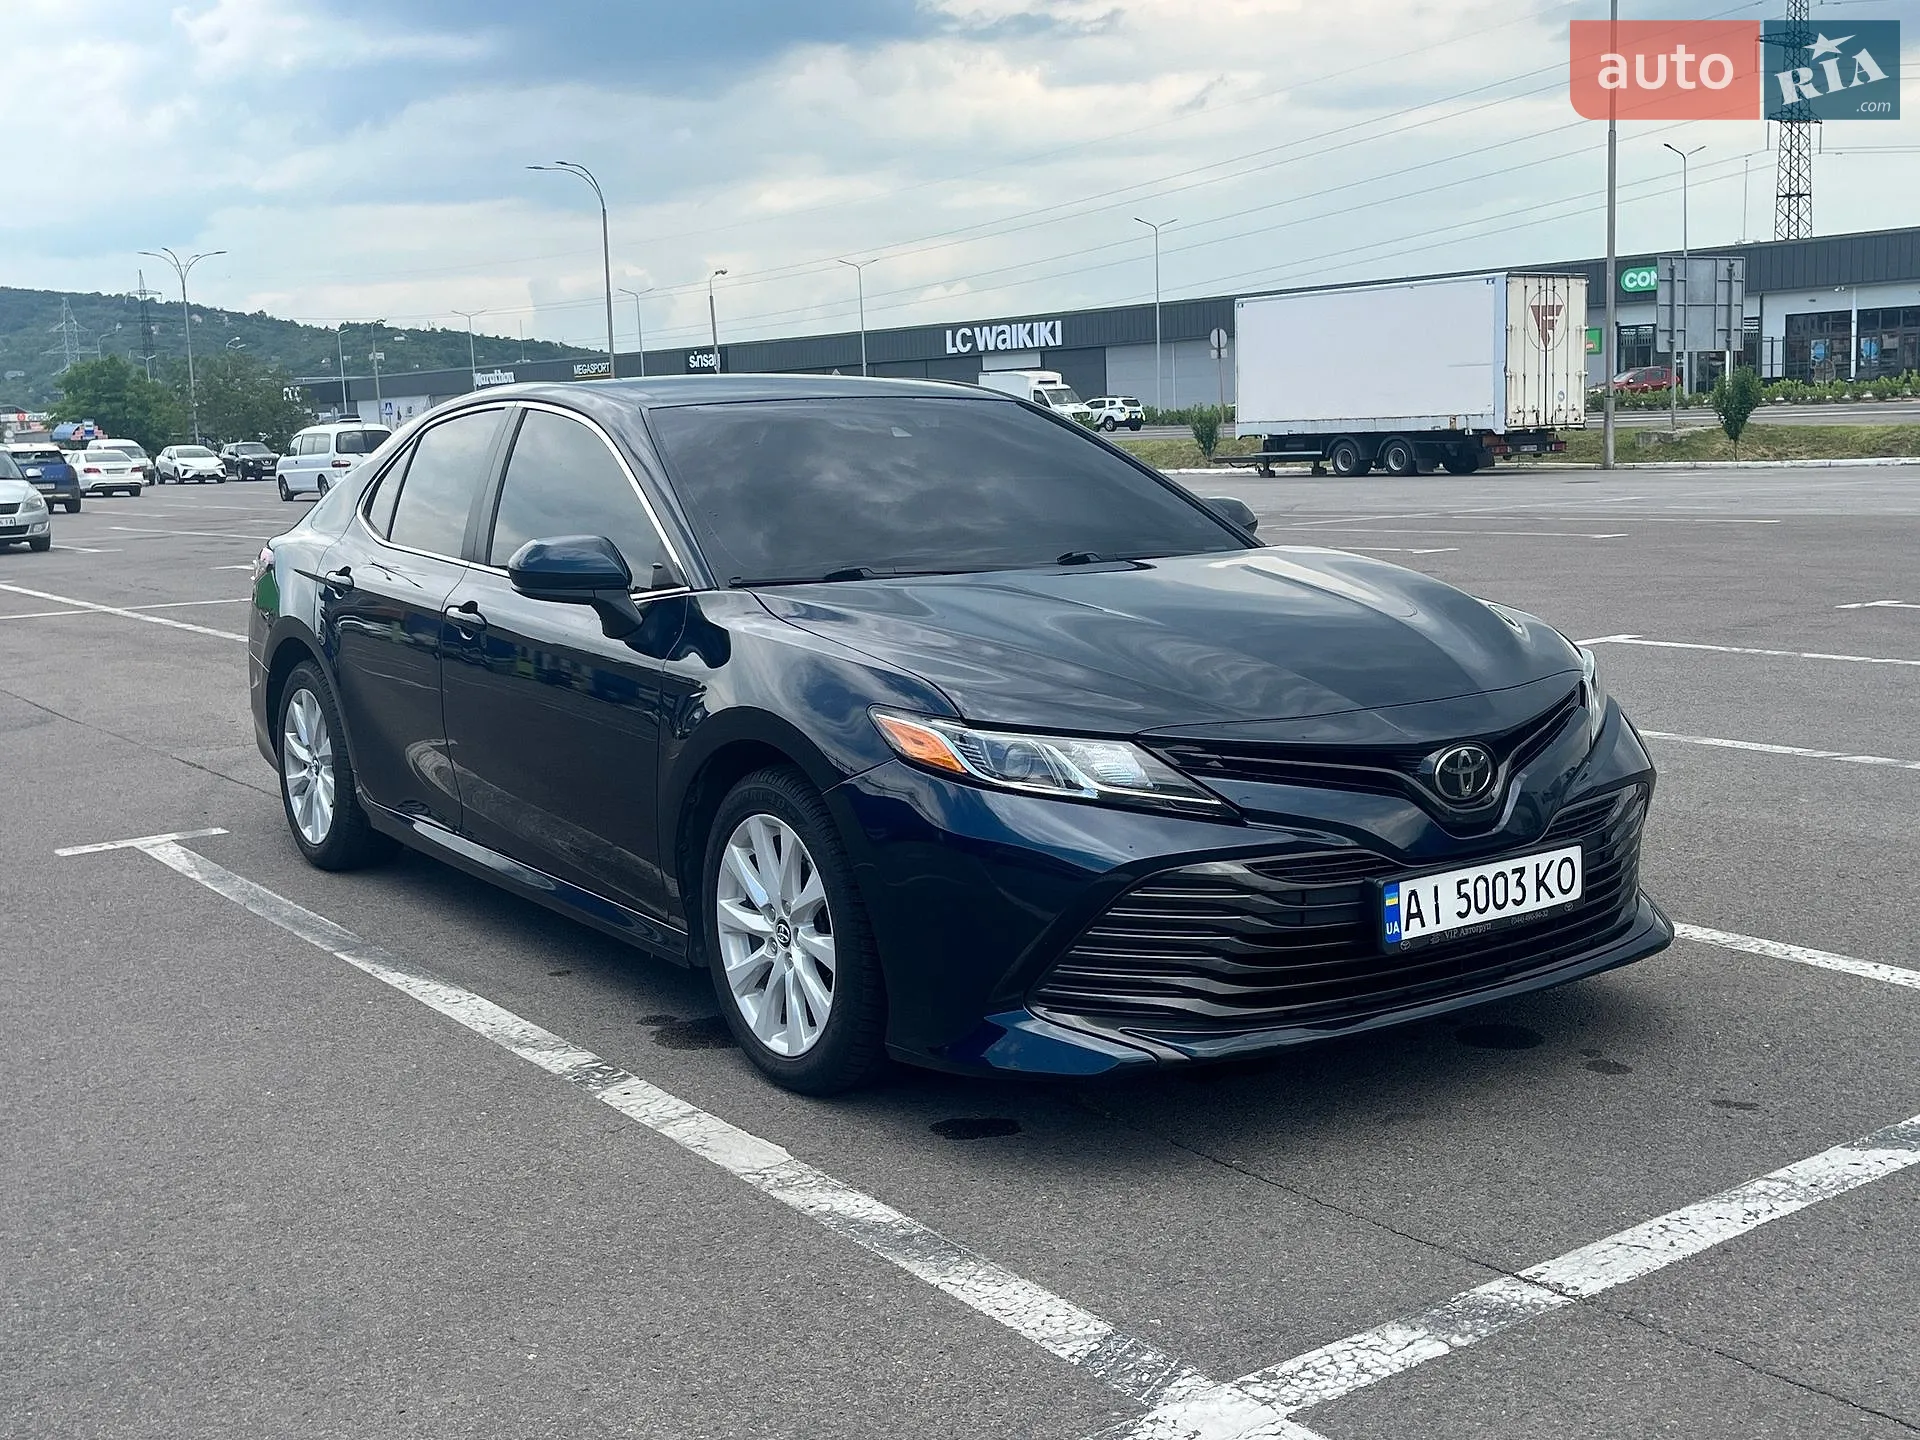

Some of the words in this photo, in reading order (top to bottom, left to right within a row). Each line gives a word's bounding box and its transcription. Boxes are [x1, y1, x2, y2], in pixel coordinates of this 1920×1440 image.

[945, 327, 973, 354] LC
[573, 361, 610, 375] MEGASPORT
[1404, 885, 1441, 931] AI
[1455, 866, 1527, 919] 5003
[1535, 856, 1576, 902] KO
[1386, 921, 1400, 935] UA
[1444, 930, 1459, 940] VIP
